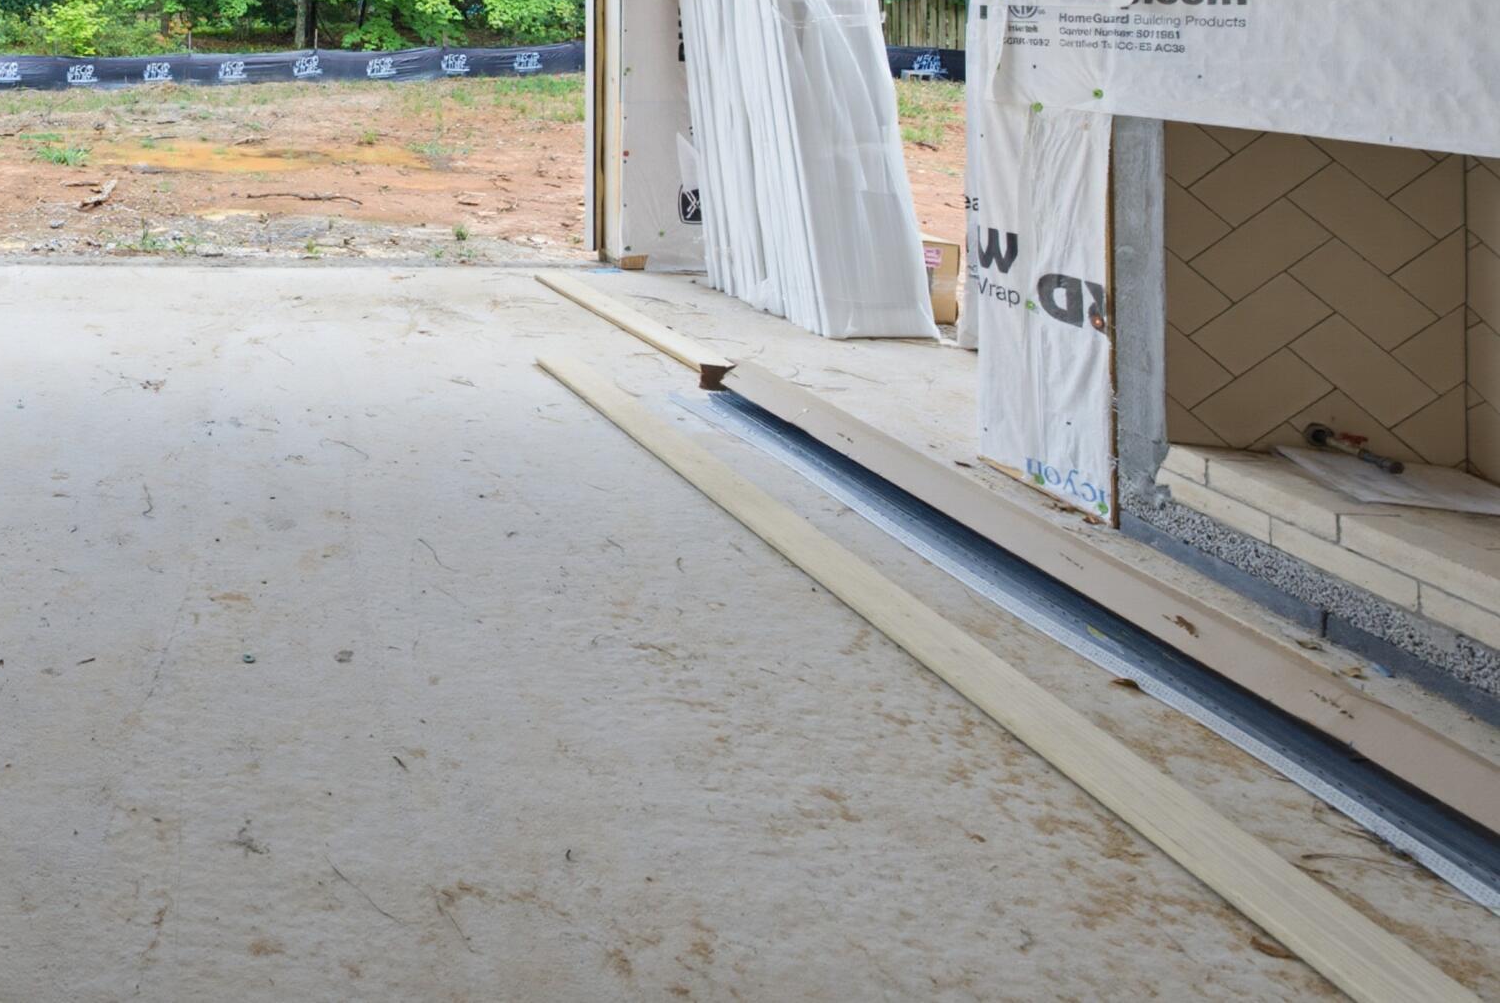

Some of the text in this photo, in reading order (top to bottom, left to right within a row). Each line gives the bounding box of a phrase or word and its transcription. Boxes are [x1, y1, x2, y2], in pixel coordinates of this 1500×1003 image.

[1058, 11, 1247, 29] HomeGuard Building Products
